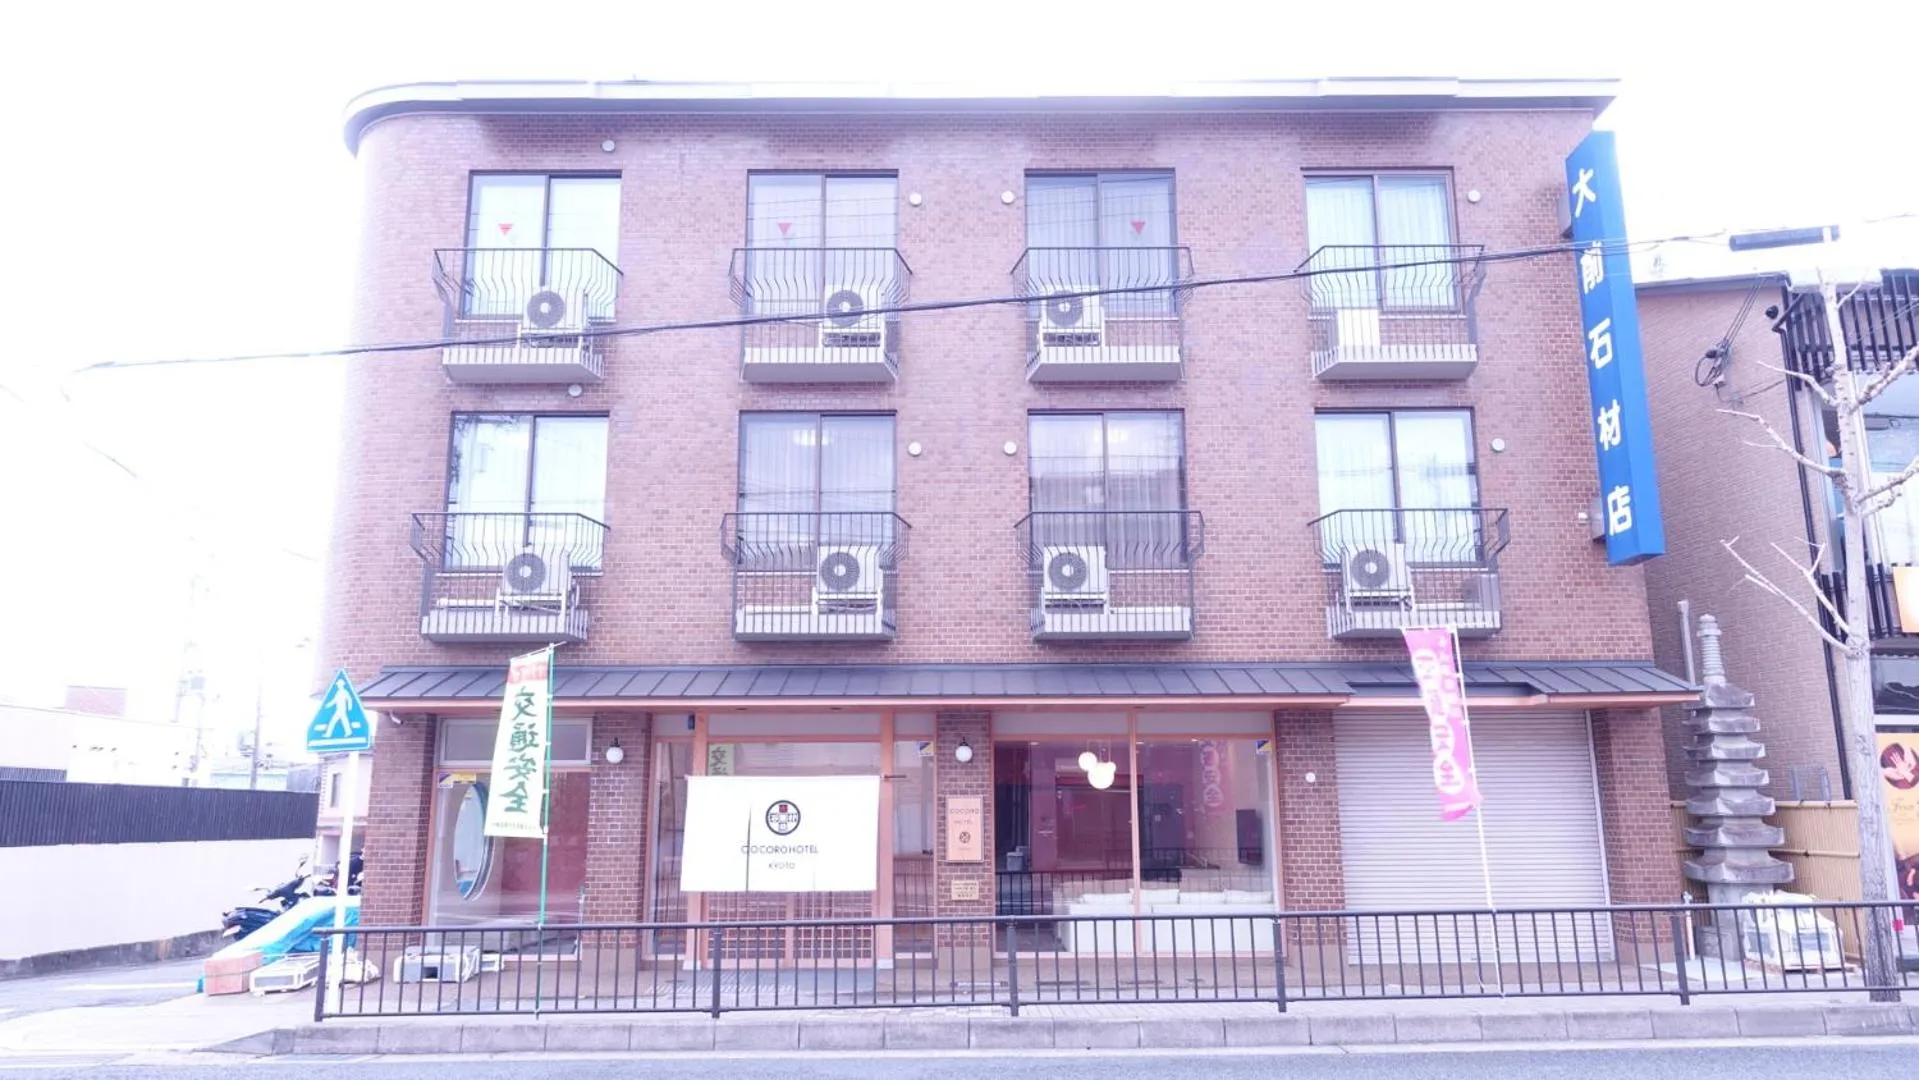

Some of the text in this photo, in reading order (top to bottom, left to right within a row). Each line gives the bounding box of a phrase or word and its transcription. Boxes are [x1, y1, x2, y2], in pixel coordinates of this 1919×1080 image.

[1572, 167, 1632, 537] 大前石材店
